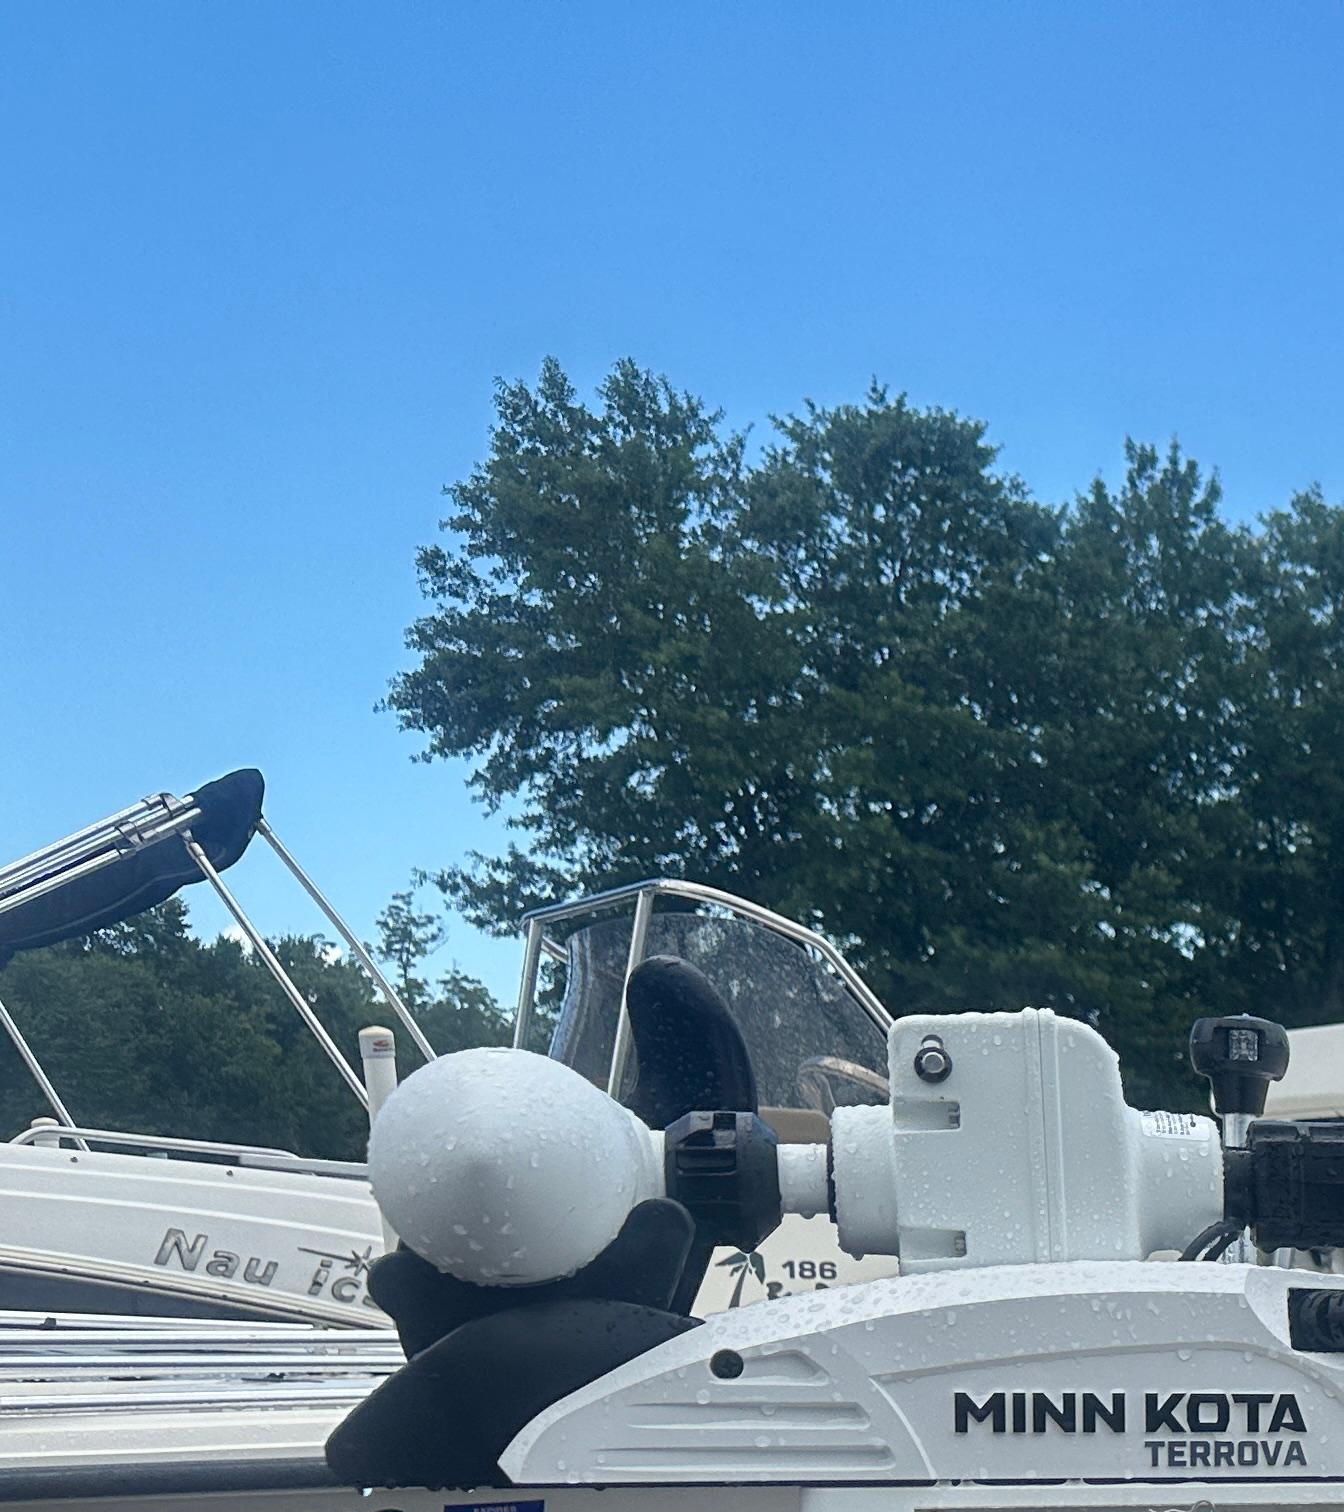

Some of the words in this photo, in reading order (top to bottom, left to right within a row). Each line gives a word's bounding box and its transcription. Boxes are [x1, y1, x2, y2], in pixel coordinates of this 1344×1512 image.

[781, 1260, 838, 1280] 186
[954, 1392, 1126, 1433] MINN
[1144, 1392, 1308, 1433] KOTA
[1144, 1440, 1308, 1467] TERROVA
